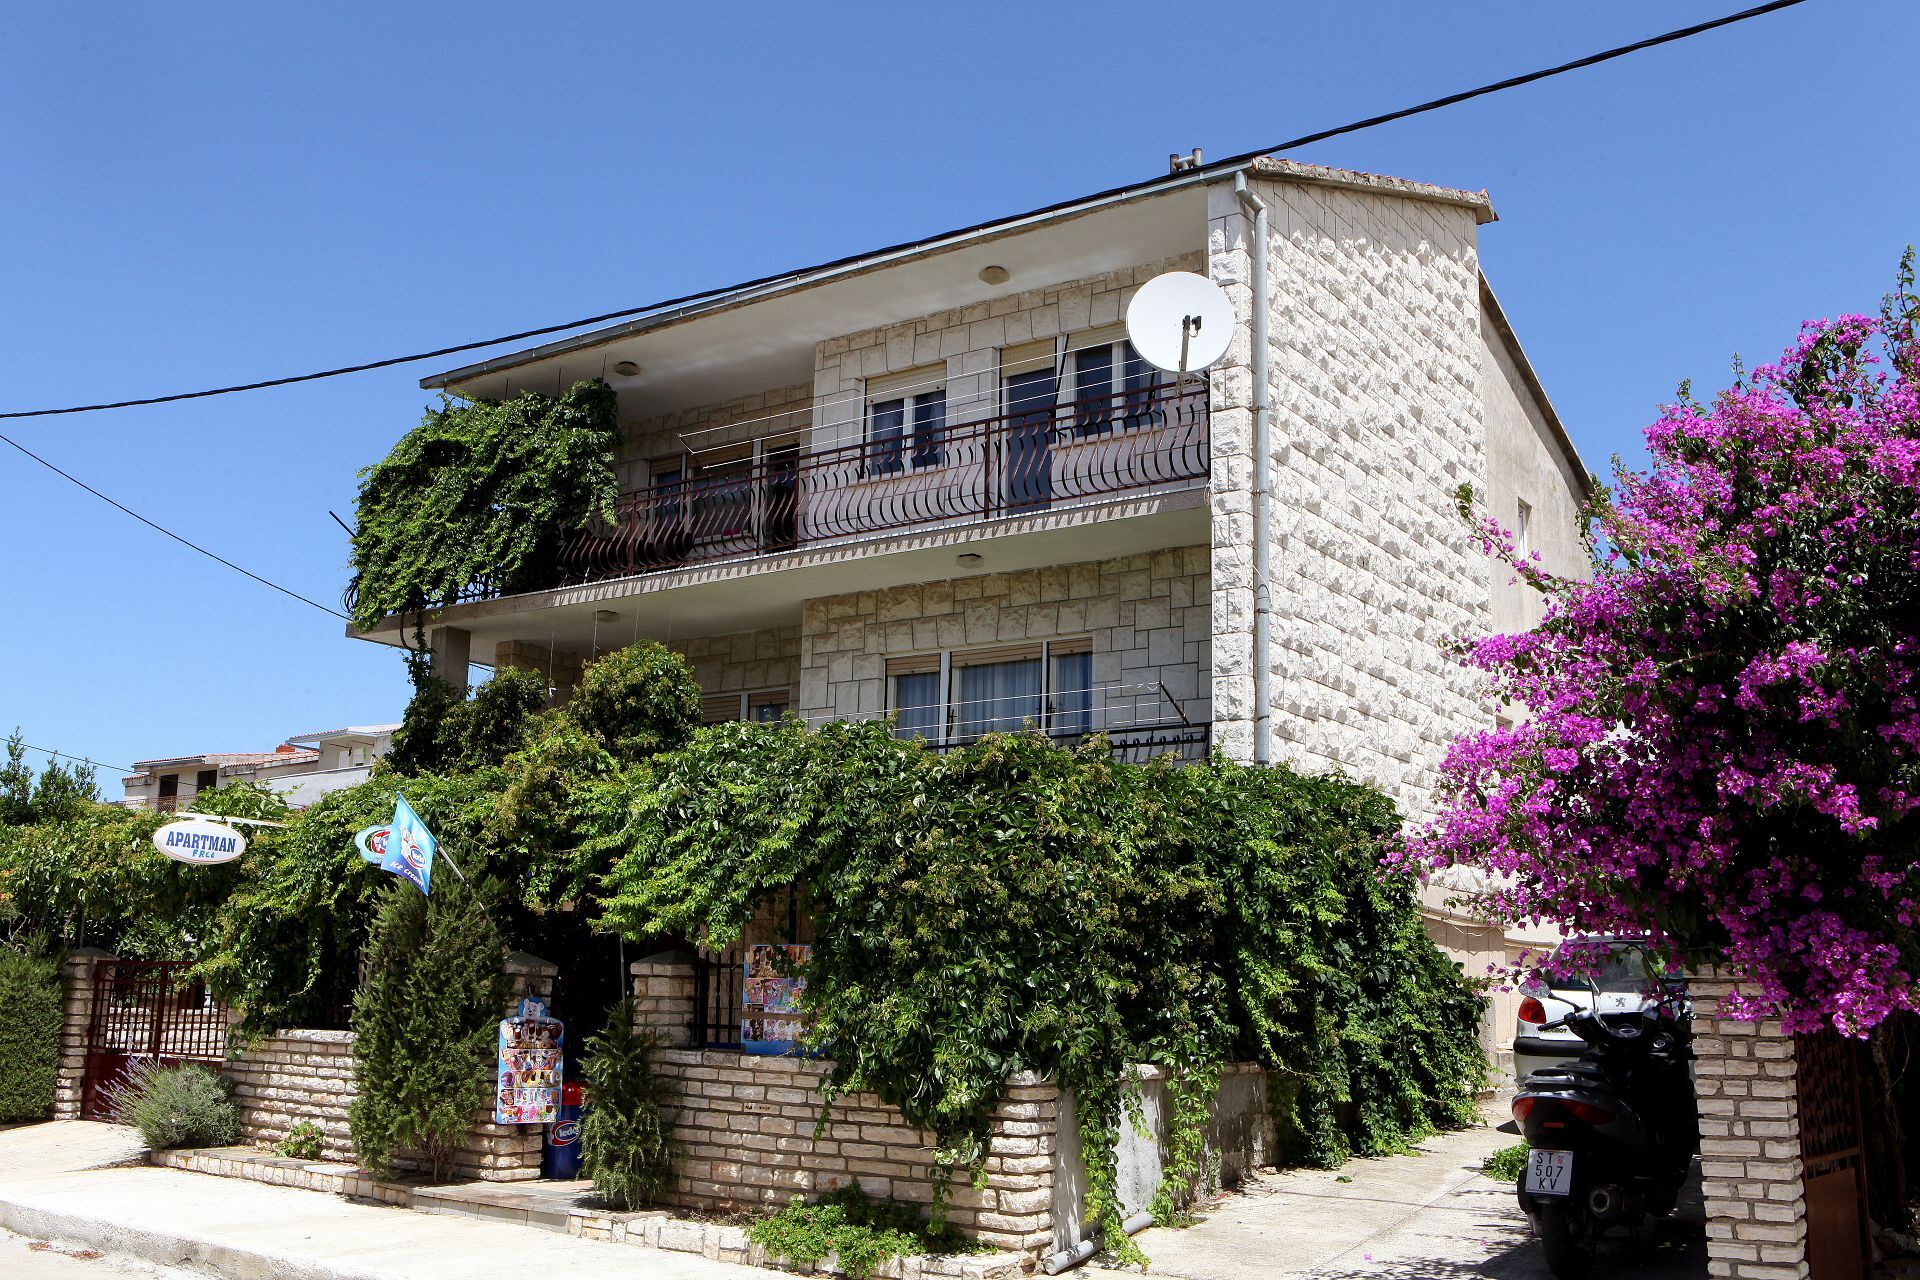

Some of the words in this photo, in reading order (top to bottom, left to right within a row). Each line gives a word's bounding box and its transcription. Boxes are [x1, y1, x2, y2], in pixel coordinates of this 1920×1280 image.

[166, 831, 236, 853] APARTMAN
[404, 868, 424, 887] cream
[1536, 1152, 1553, 1164] ST
[1535, 1164, 1564, 1178] 507
[1538, 1177, 1557, 1190] KV
